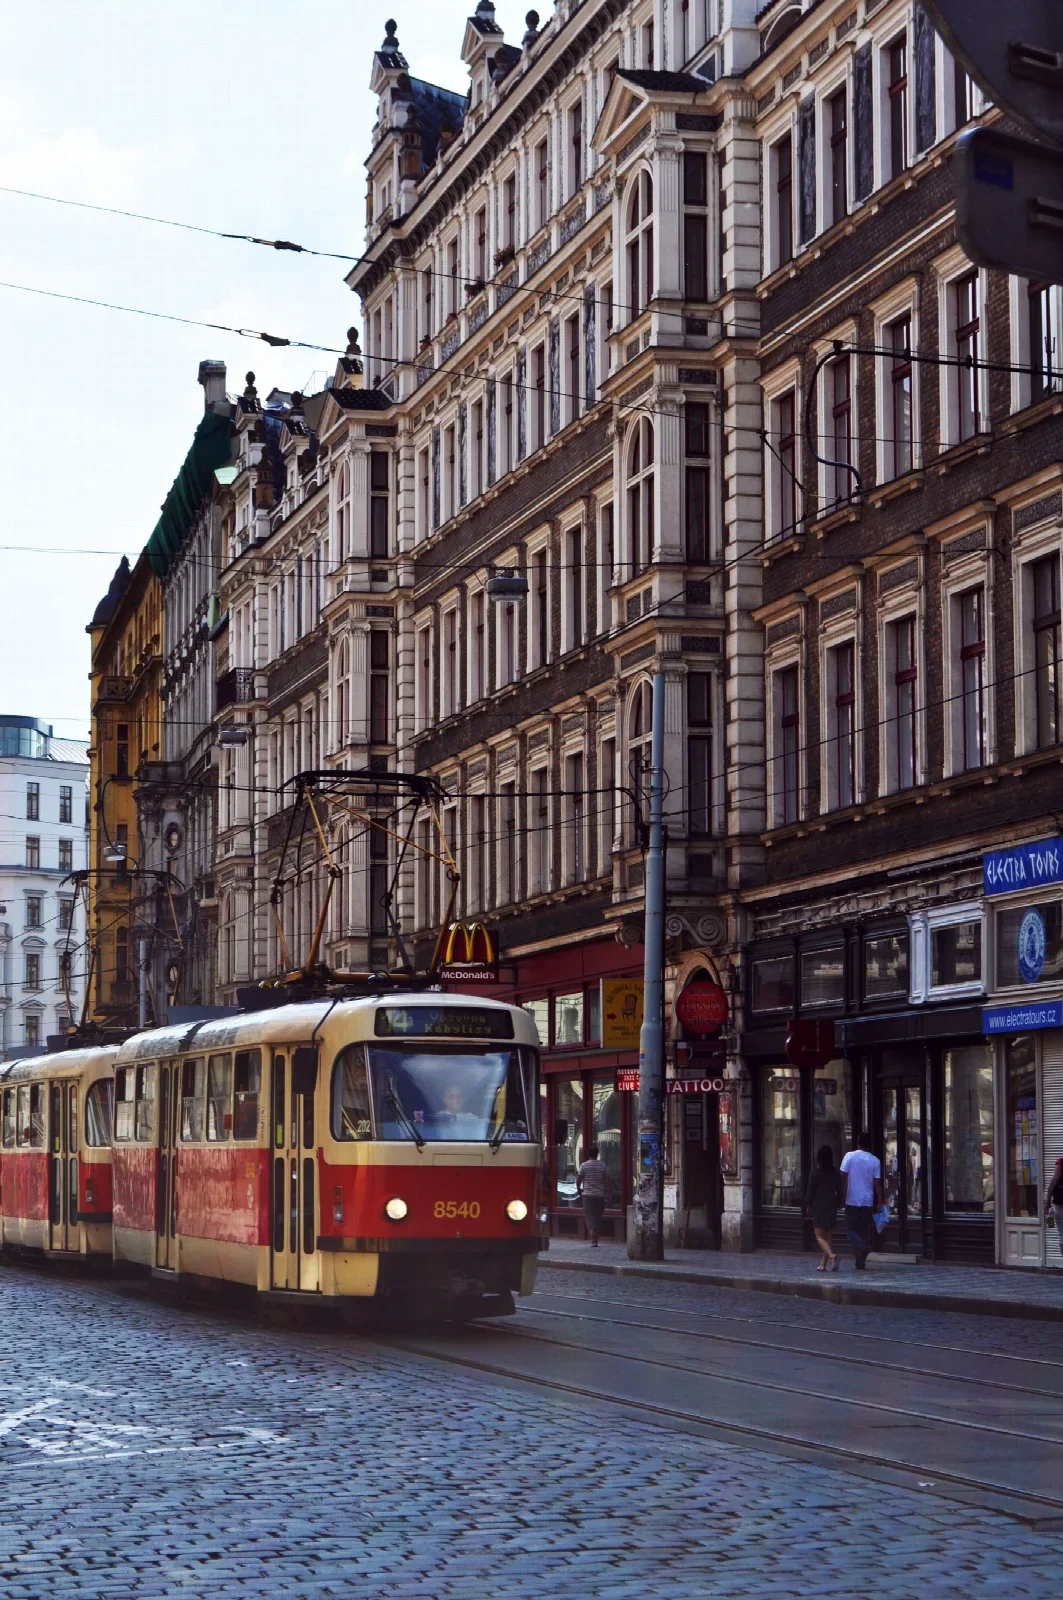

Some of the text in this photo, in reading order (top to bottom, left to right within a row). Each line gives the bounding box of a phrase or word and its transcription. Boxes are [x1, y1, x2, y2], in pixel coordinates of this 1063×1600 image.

[986, 856, 1027, 884] ELECTRA
[441, 971, 495, 979] McDonald's
[988, 1010, 1056, 1028] www.electratours.cz
[424, 1023, 492, 1034] Kobylisy
[665, 1079, 724, 1093] TATTOO
[433, 1201, 481, 1219] 8540
